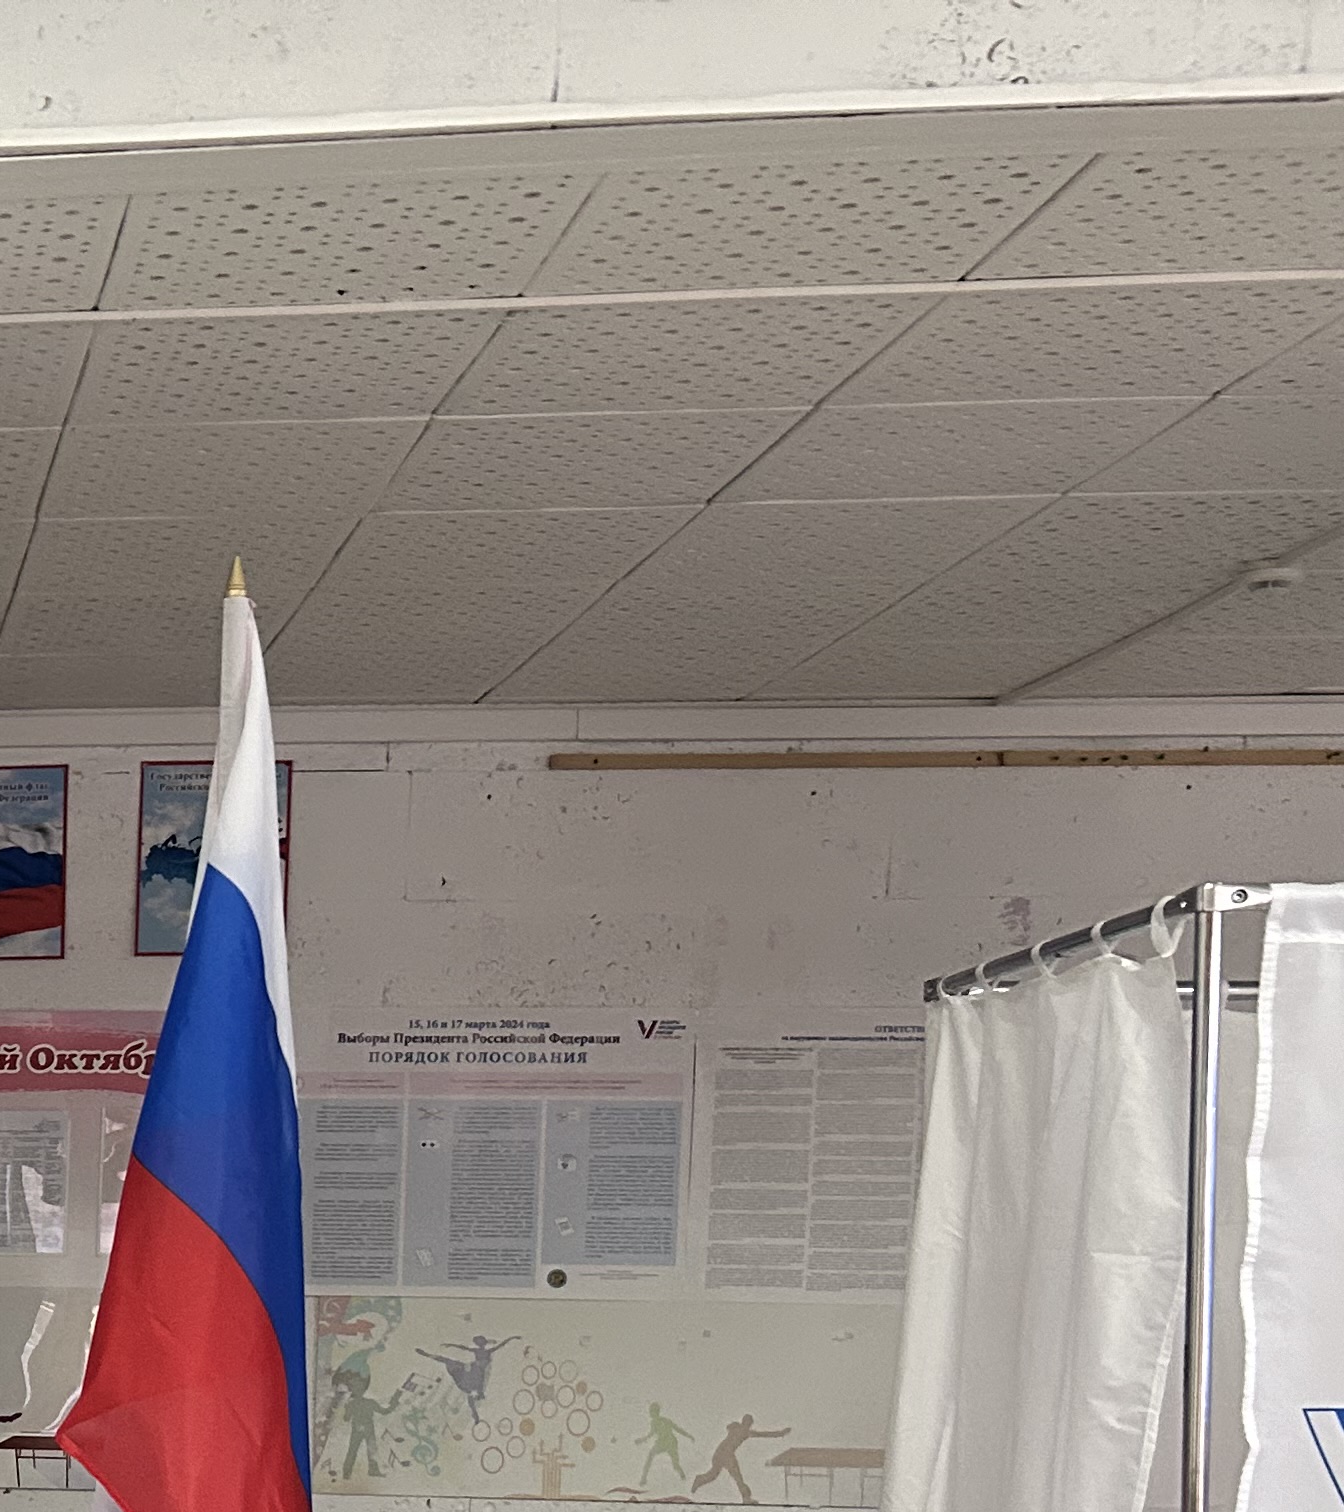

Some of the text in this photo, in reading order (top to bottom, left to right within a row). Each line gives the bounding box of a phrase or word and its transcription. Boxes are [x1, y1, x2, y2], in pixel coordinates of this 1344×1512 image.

[408, 1020, 423, 1030] 15,
[426, 1020, 439, 1029] 16
[451, 1020, 462, 1029] 17
[465, 1021, 497, 1031] марта
[500, 1020, 524, 1029] 2024
[527, 1021, 550, 1030] года
[337, 1033, 620, 1046] Выборы Президента Российской Федерации
[368, 1051, 588, 1065] ПОРЯДОК ГОЛОСОВАНИЯ
